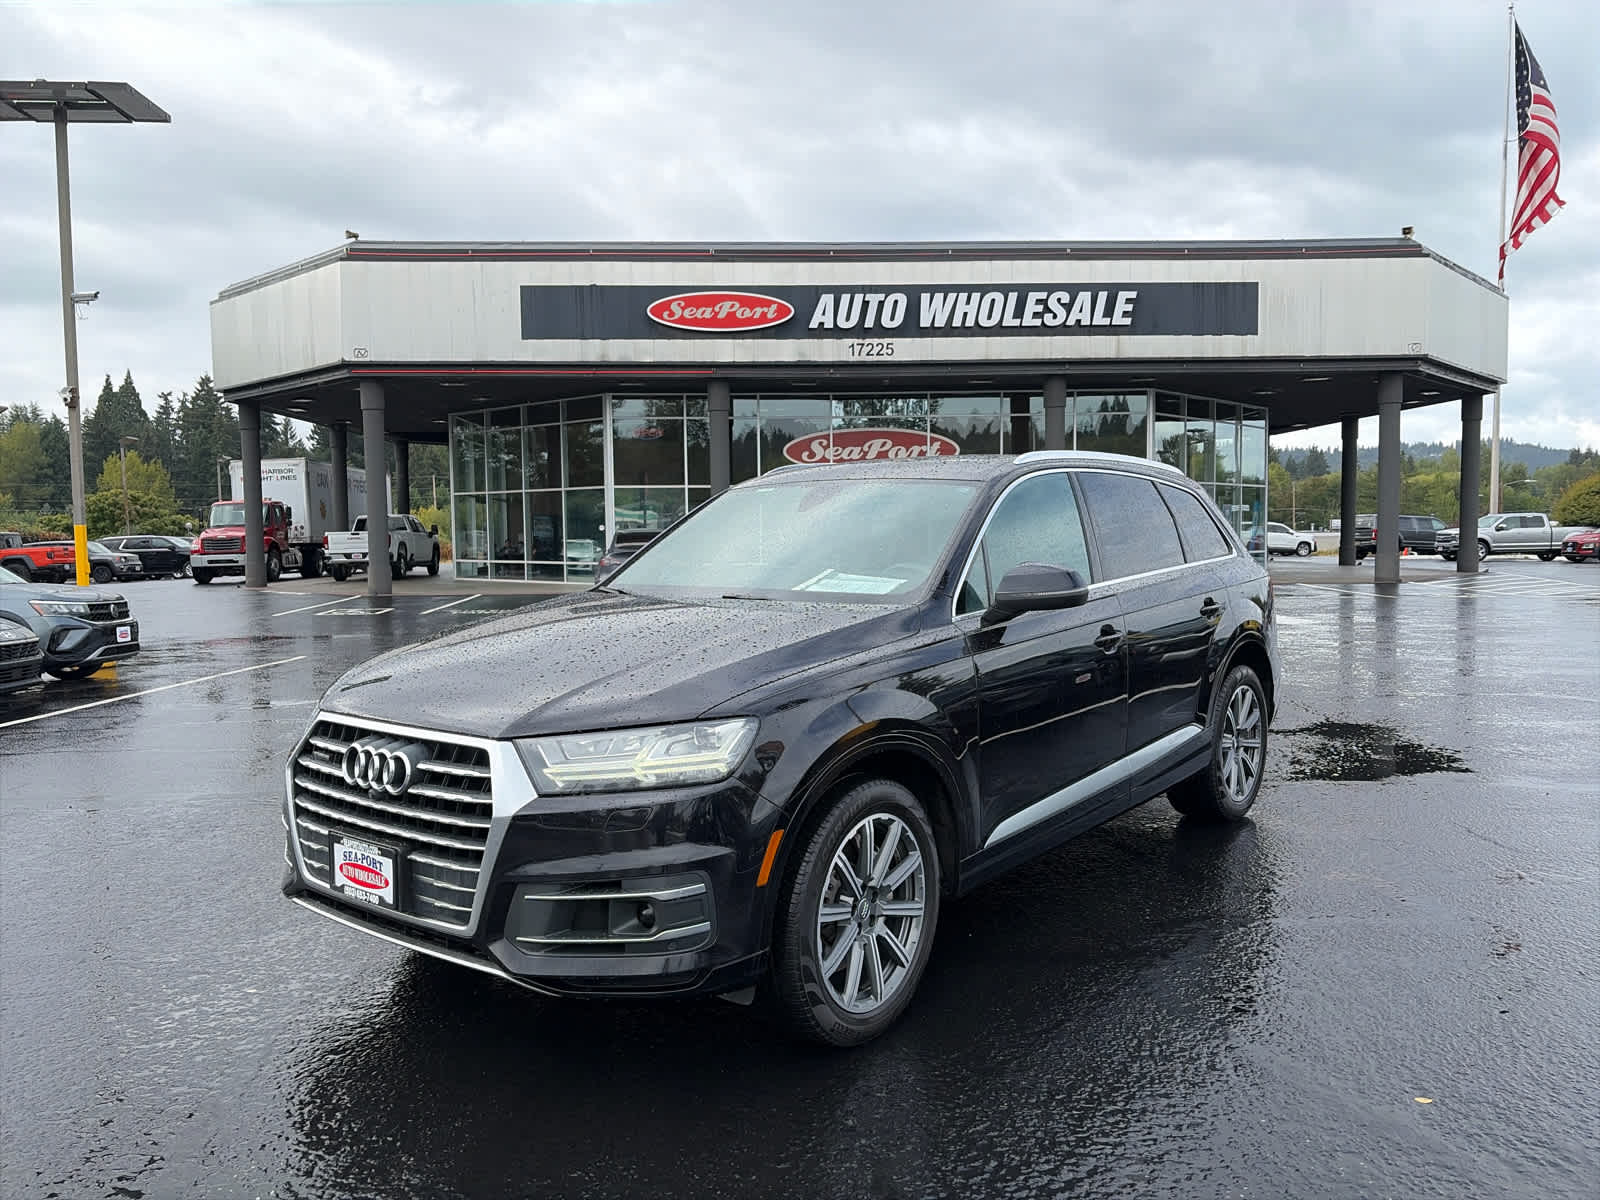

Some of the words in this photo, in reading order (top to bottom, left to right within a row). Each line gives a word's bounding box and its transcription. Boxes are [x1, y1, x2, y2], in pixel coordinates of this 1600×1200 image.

[662, 300, 779, 321] SeaPort
[808, 292, 908, 330] AUTO
[919, 290, 1138, 329] WHOLESALE
[848, 342, 895, 357] 17225
[801, 438, 941, 463] SeaPort
[262, 467, 294, 475] HARBOR
